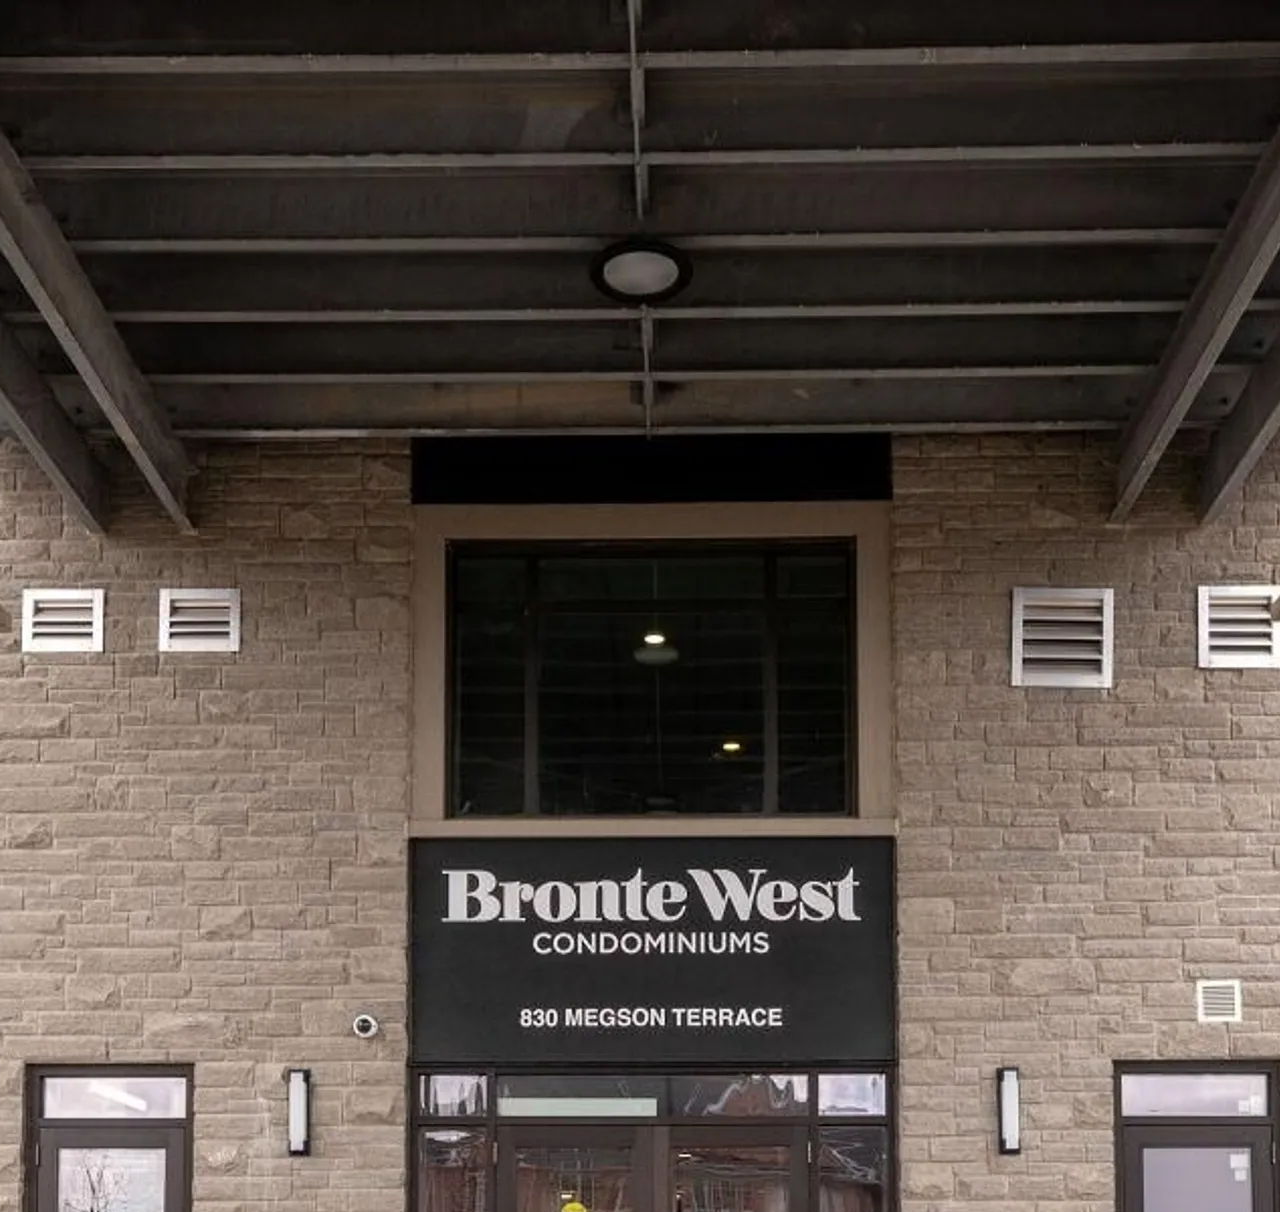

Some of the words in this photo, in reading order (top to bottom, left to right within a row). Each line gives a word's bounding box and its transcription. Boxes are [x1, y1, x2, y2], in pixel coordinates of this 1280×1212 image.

[441, 867, 688, 922] Bronte
[687, 867, 862, 922] West
[532, 932, 770, 955] CONDOMINIUMS
[519, 1008, 558, 1028] 830
[564, 1008, 666, 1028] MEGSON
[671, 1008, 783, 1027] TERRACE
